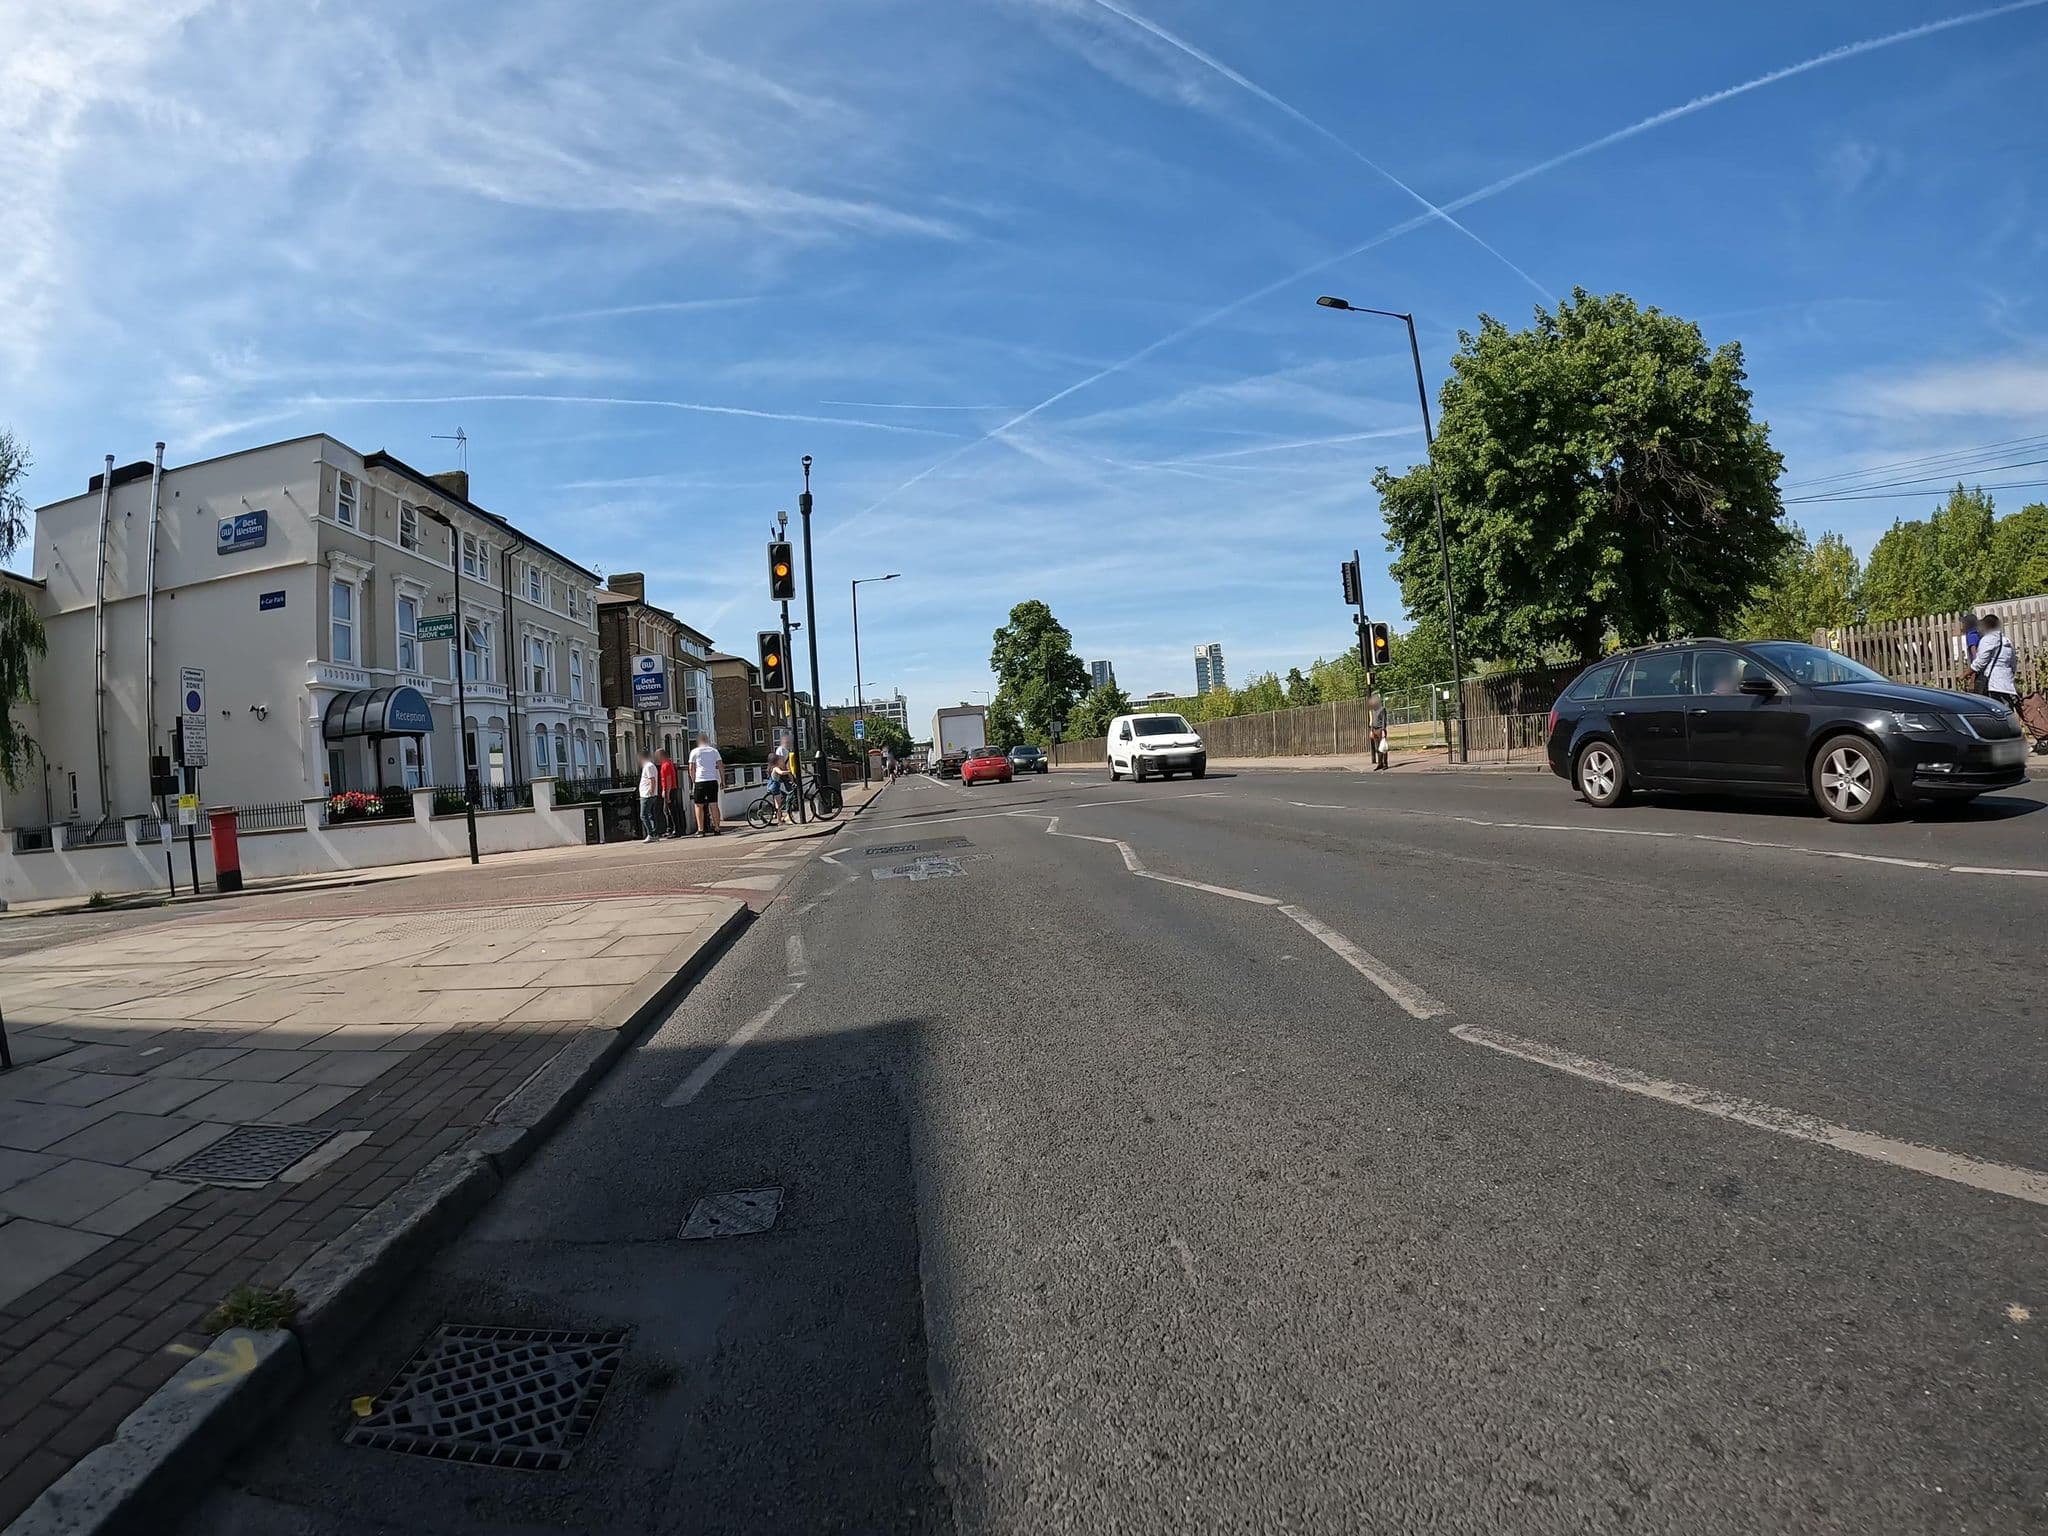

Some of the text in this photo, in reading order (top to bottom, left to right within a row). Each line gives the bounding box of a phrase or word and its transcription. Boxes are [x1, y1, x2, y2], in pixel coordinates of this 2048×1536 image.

[243, 519, 257, 528] Best
[236, 525, 263, 536] Western
[419, 623, 453, 633] ALEXANDRA
[418, 631, 438, 639] GROVE
[635, 683, 662, 691] Western
[395, 710, 426, 722] Reception
